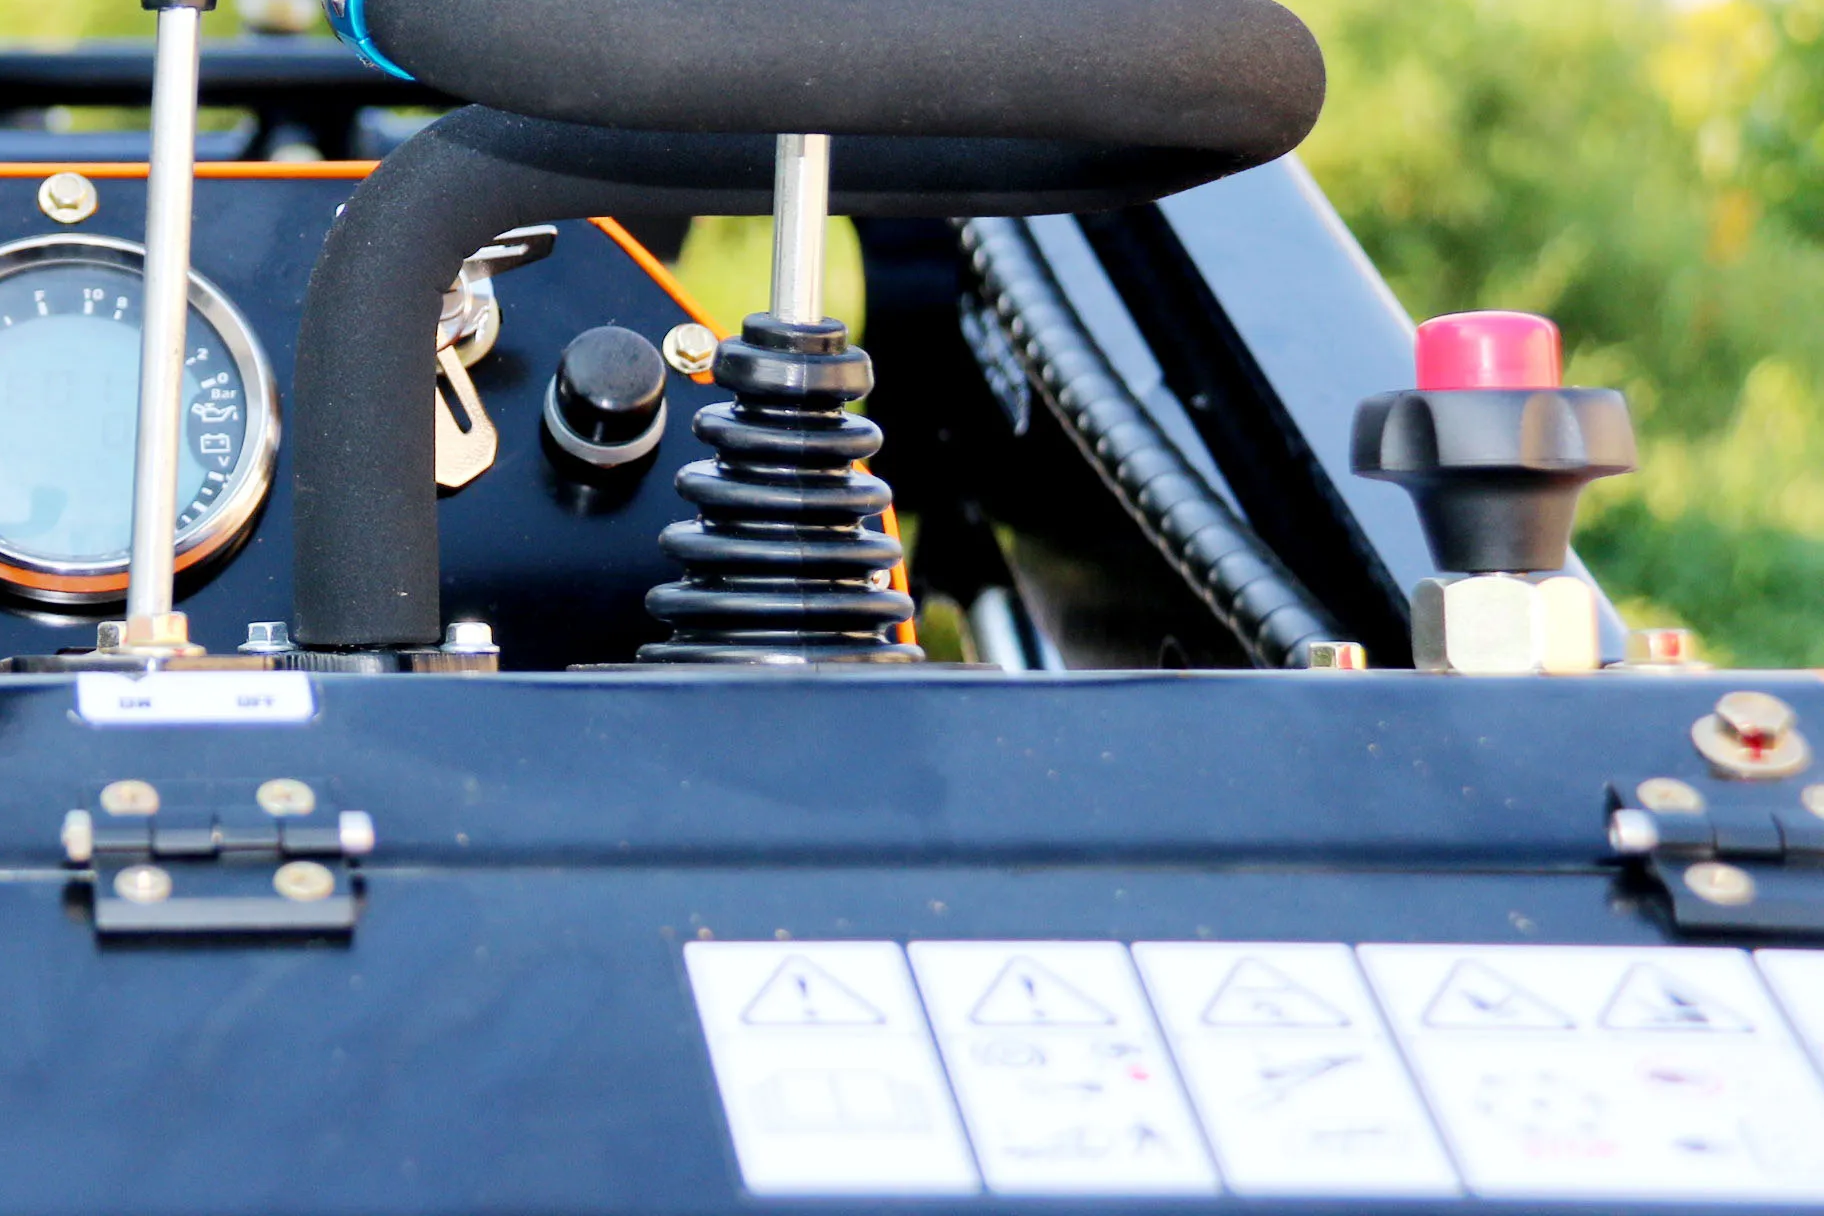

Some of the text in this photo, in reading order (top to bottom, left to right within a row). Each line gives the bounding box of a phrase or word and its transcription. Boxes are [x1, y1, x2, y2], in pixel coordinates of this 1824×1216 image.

[83, 288, 104, 300] 10
[197, 348, 209, 360] 2
[211, 388, 237, 400] Bar
